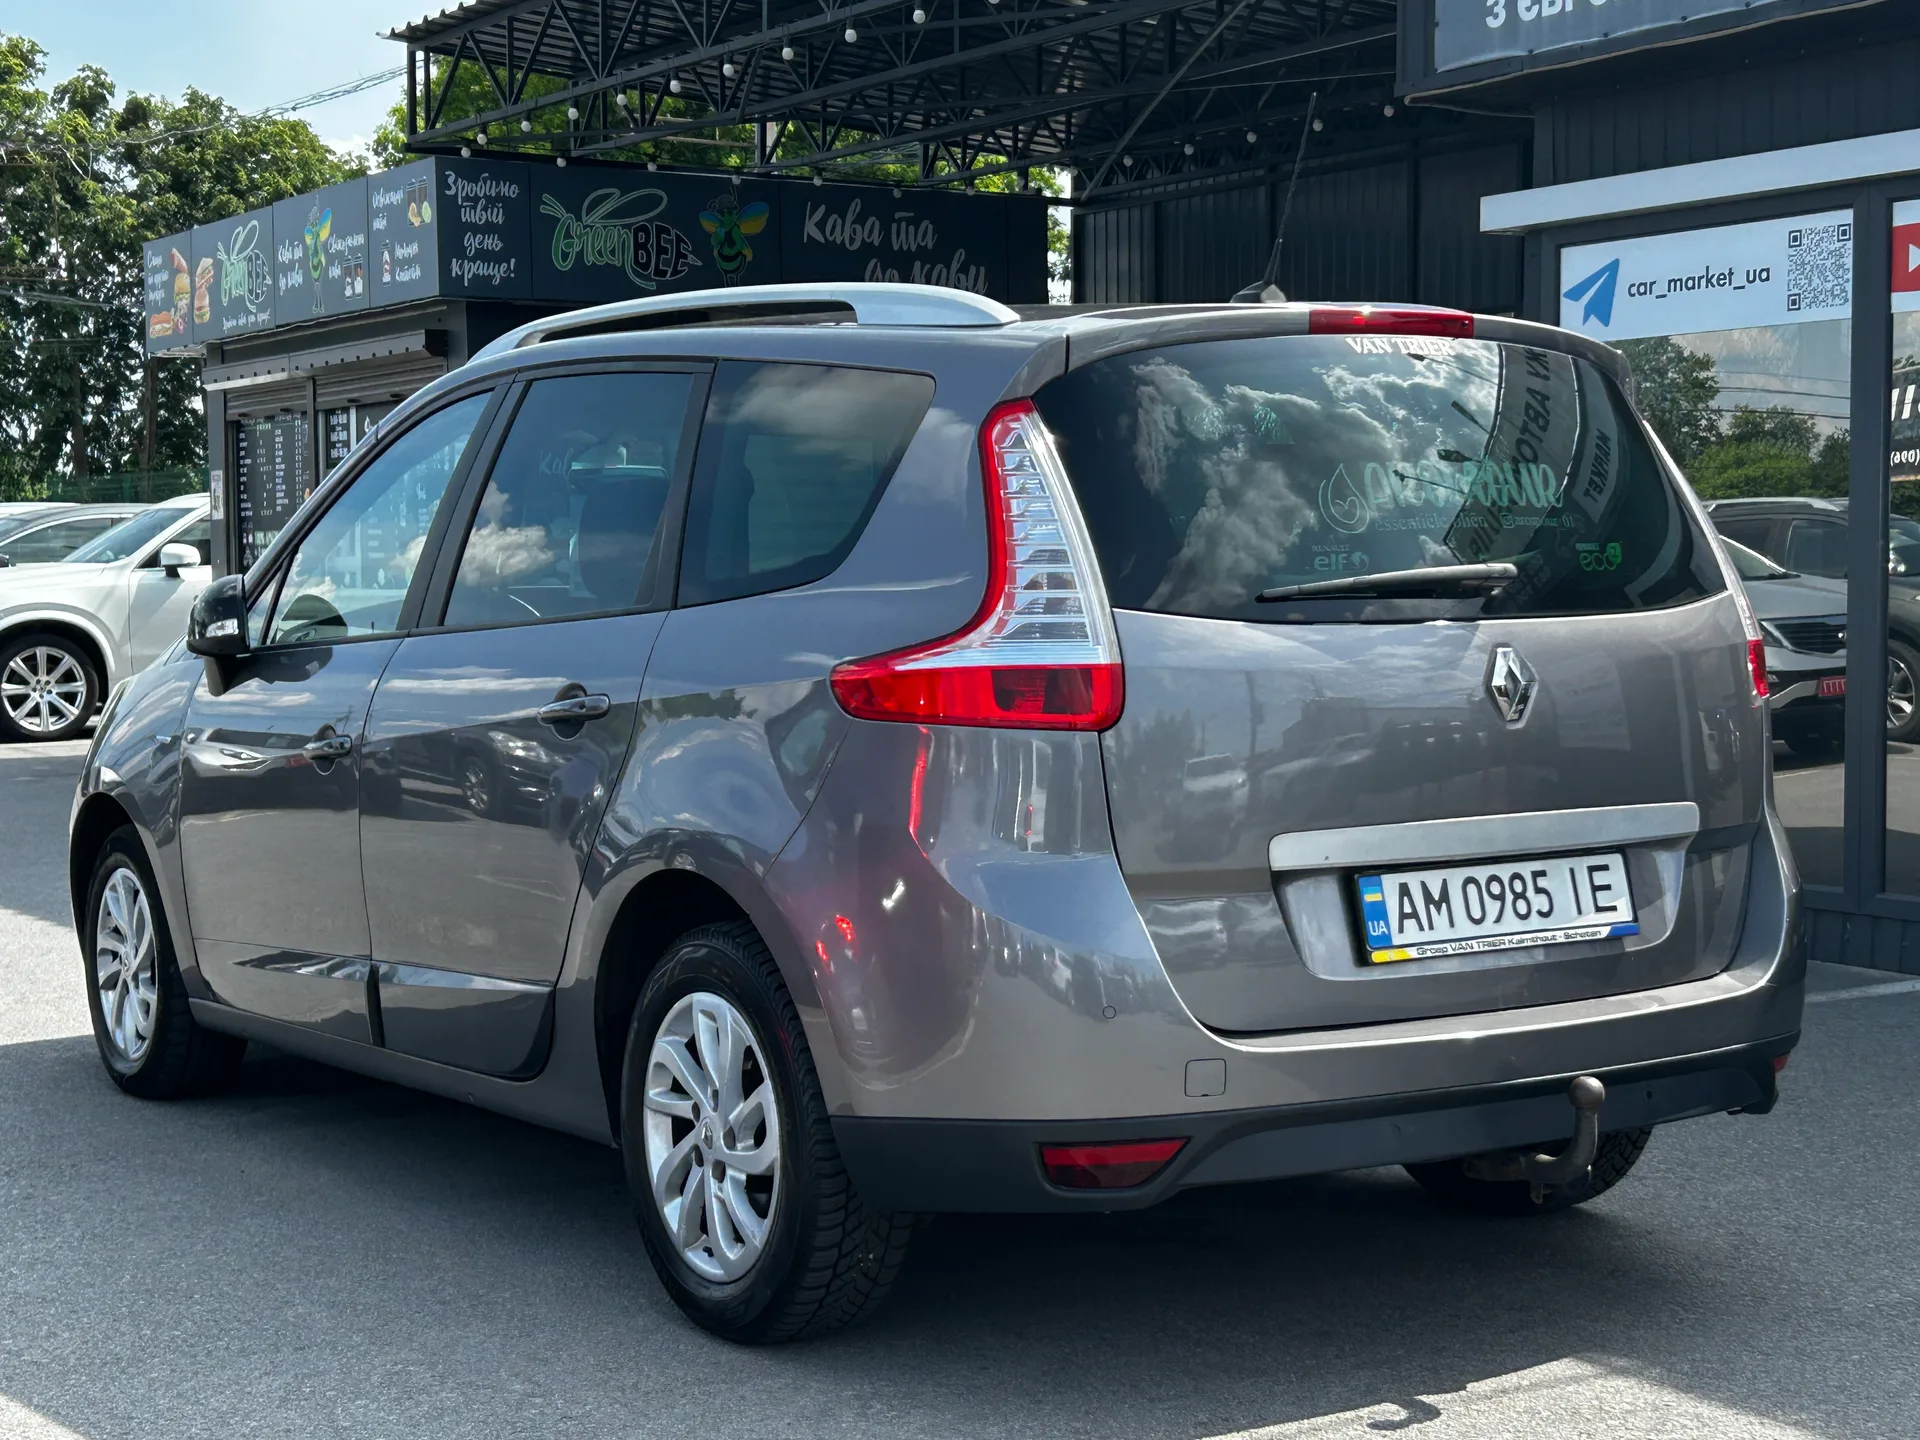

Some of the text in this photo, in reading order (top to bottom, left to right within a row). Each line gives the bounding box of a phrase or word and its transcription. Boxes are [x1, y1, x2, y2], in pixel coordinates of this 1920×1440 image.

[444, 170, 520, 205] Зробимо
[460, 202, 505, 225] твій
[803, 198, 938, 252] Кава та
[463, 231, 503, 257] день
[450, 258, 516, 286] краще!
[1627, 265, 1771, 299] car_market_ua
[1345, 337, 1455, 356] VAN TRIER
[1314, 553, 1348, 571] elf
[1397, 863, 1618, 934] AM 0985 IE
[1368, 920, 1388, 936] UA
[1449, 942, 1475, 953] VAN
[1477, 938, 1506, 949] TRIER
